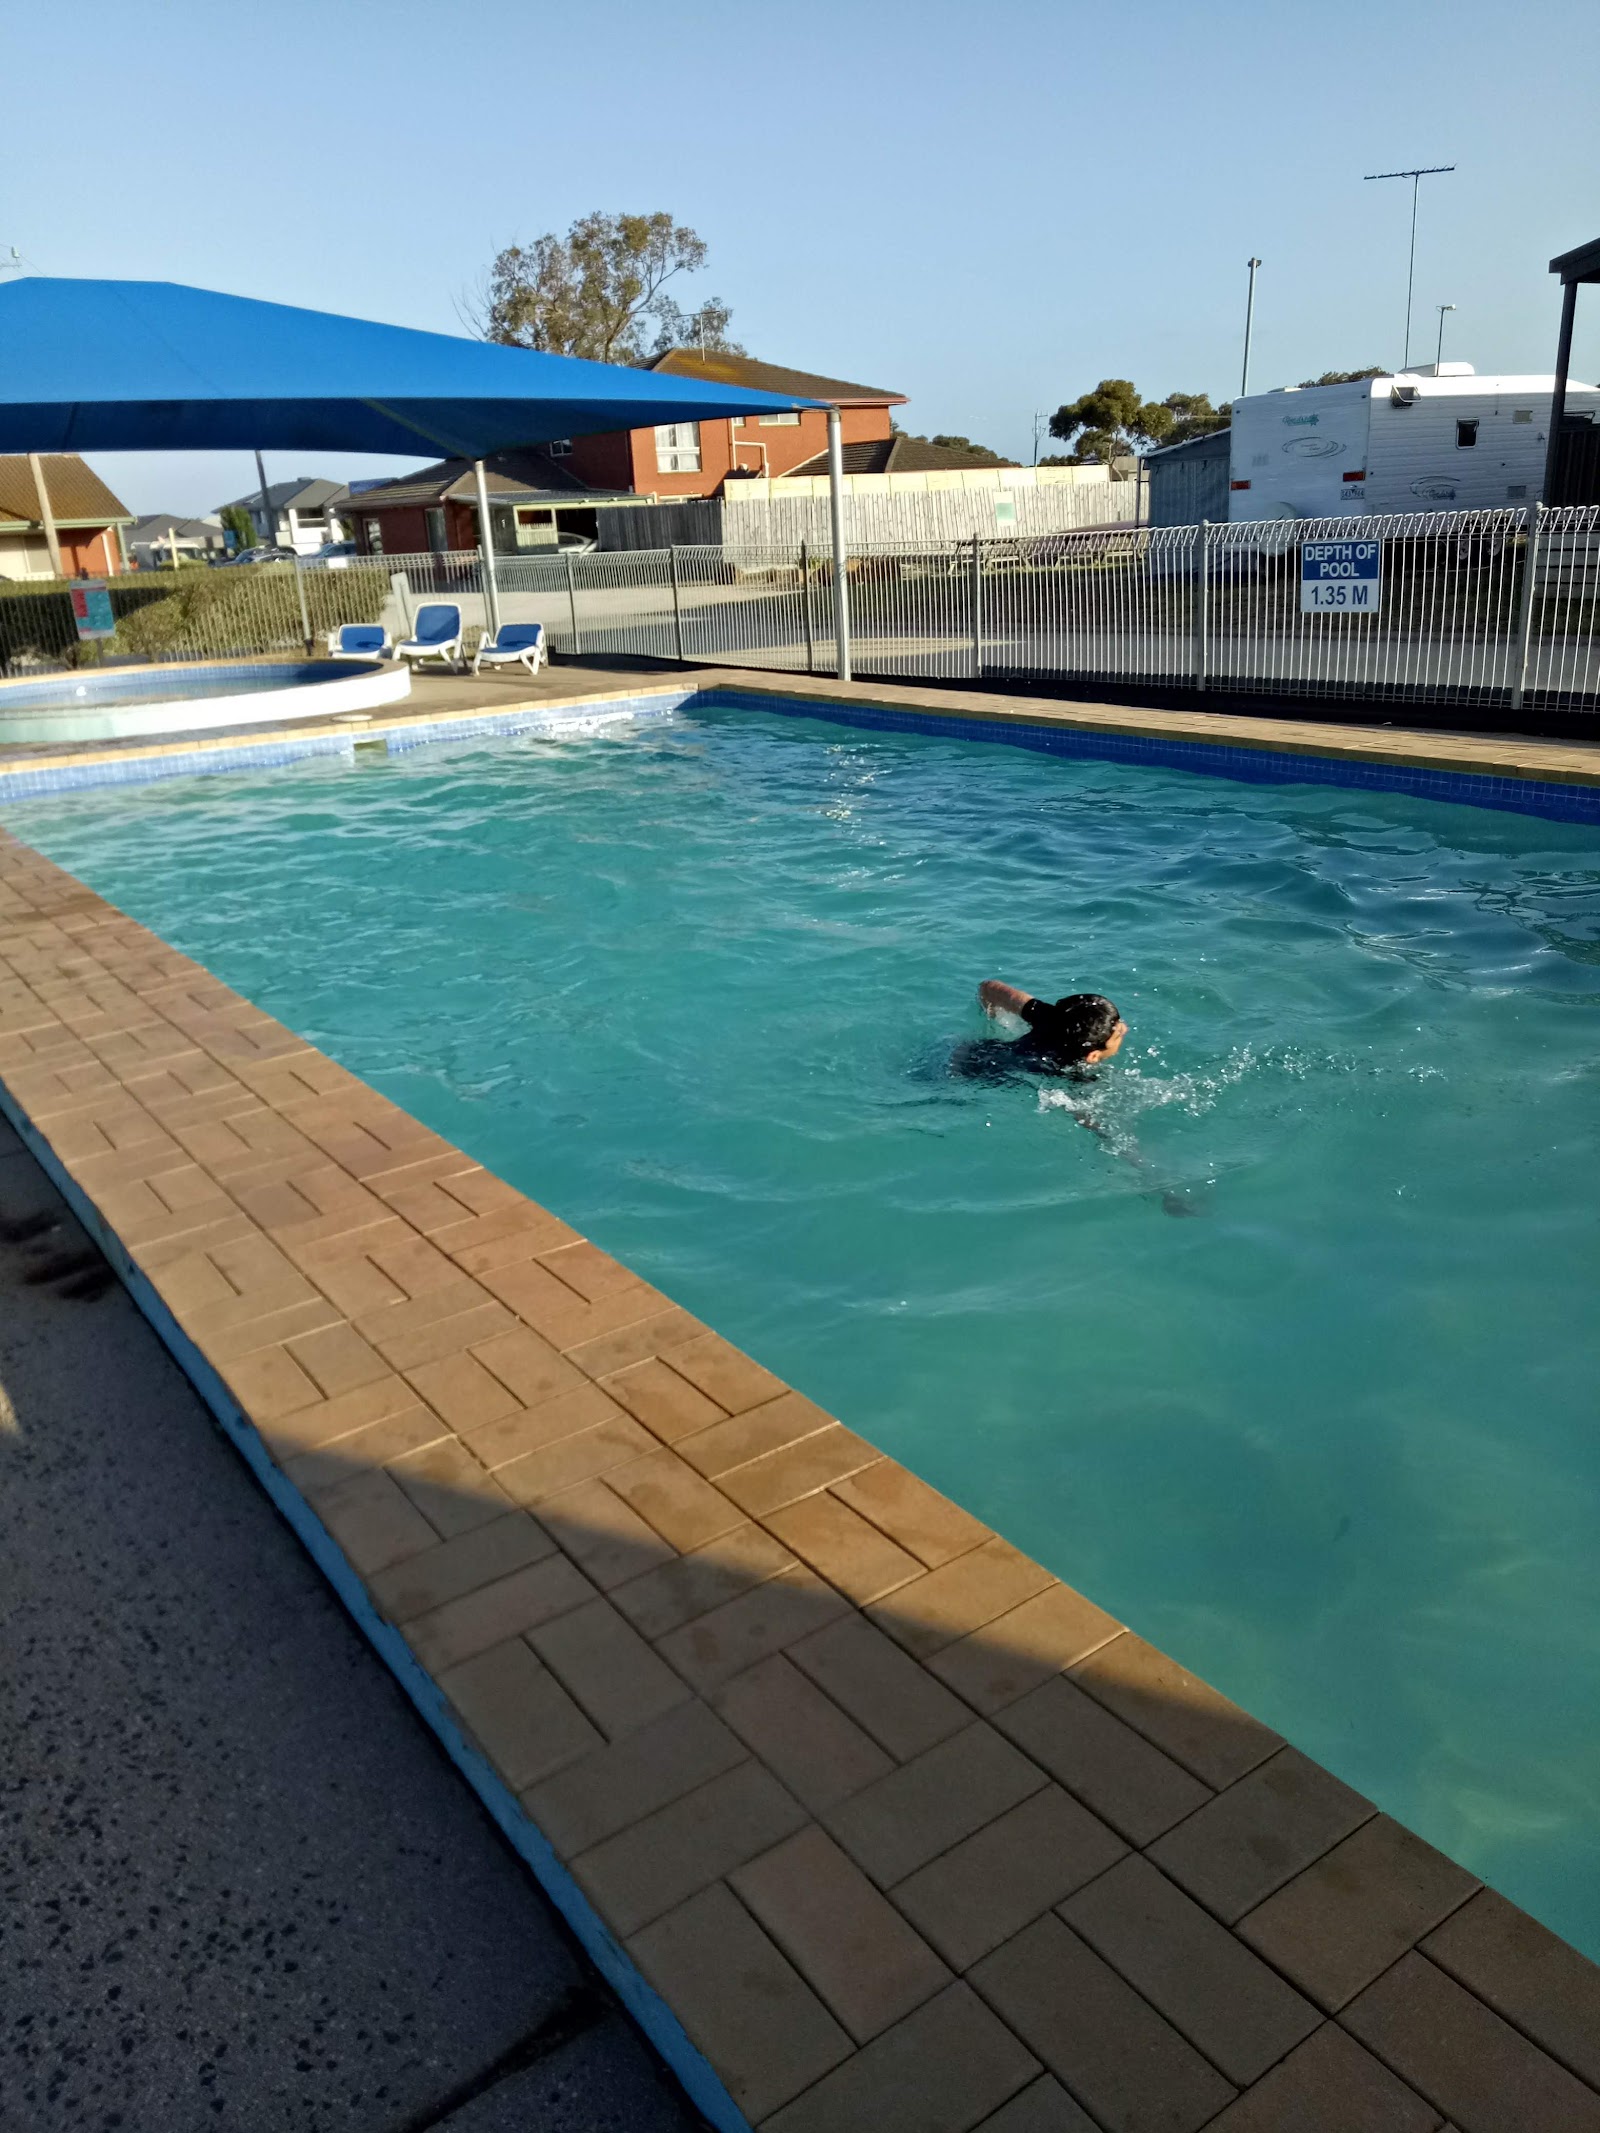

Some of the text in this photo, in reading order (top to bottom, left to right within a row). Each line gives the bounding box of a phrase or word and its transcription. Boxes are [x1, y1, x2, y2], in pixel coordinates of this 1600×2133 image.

[1304, 543, 1377, 561] DEPTH OF
[1320, 561, 1360, 577] POOL
[1311, 585, 1368, 605] 1.35 M
